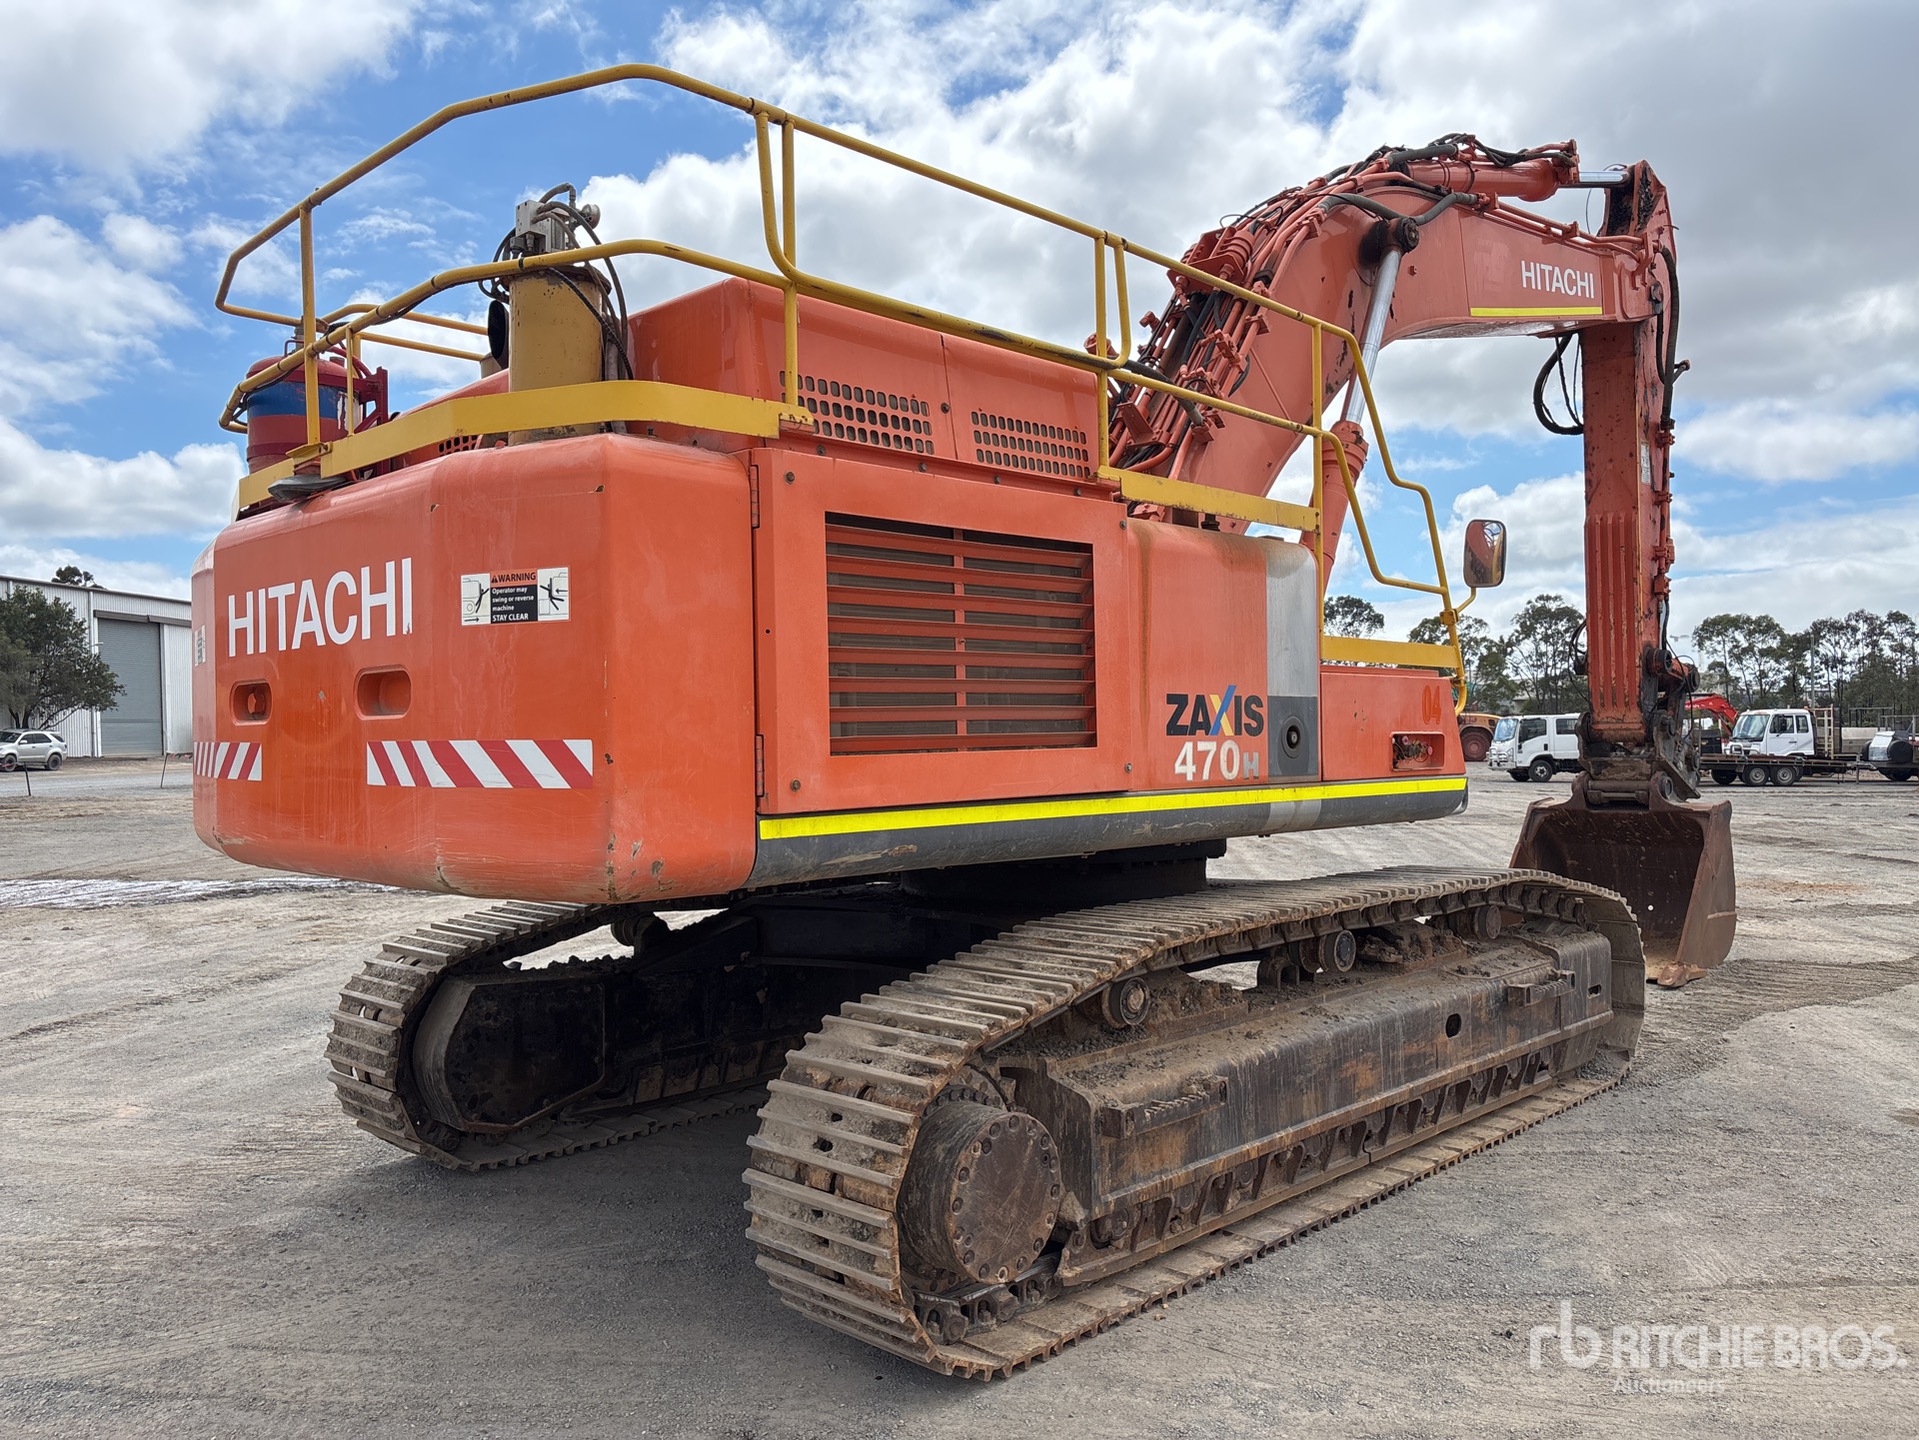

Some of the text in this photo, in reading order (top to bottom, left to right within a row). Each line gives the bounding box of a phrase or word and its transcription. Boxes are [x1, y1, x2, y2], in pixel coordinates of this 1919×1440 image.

[1521, 260, 1595, 299] HITACHI
[498, 572, 536, 582] WARNING
[228, 557, 413, 658] HITACHI
[492, 612, 529, 622] STAY CLEAR
[1166, 684, 1265, 737] ZAXIS
